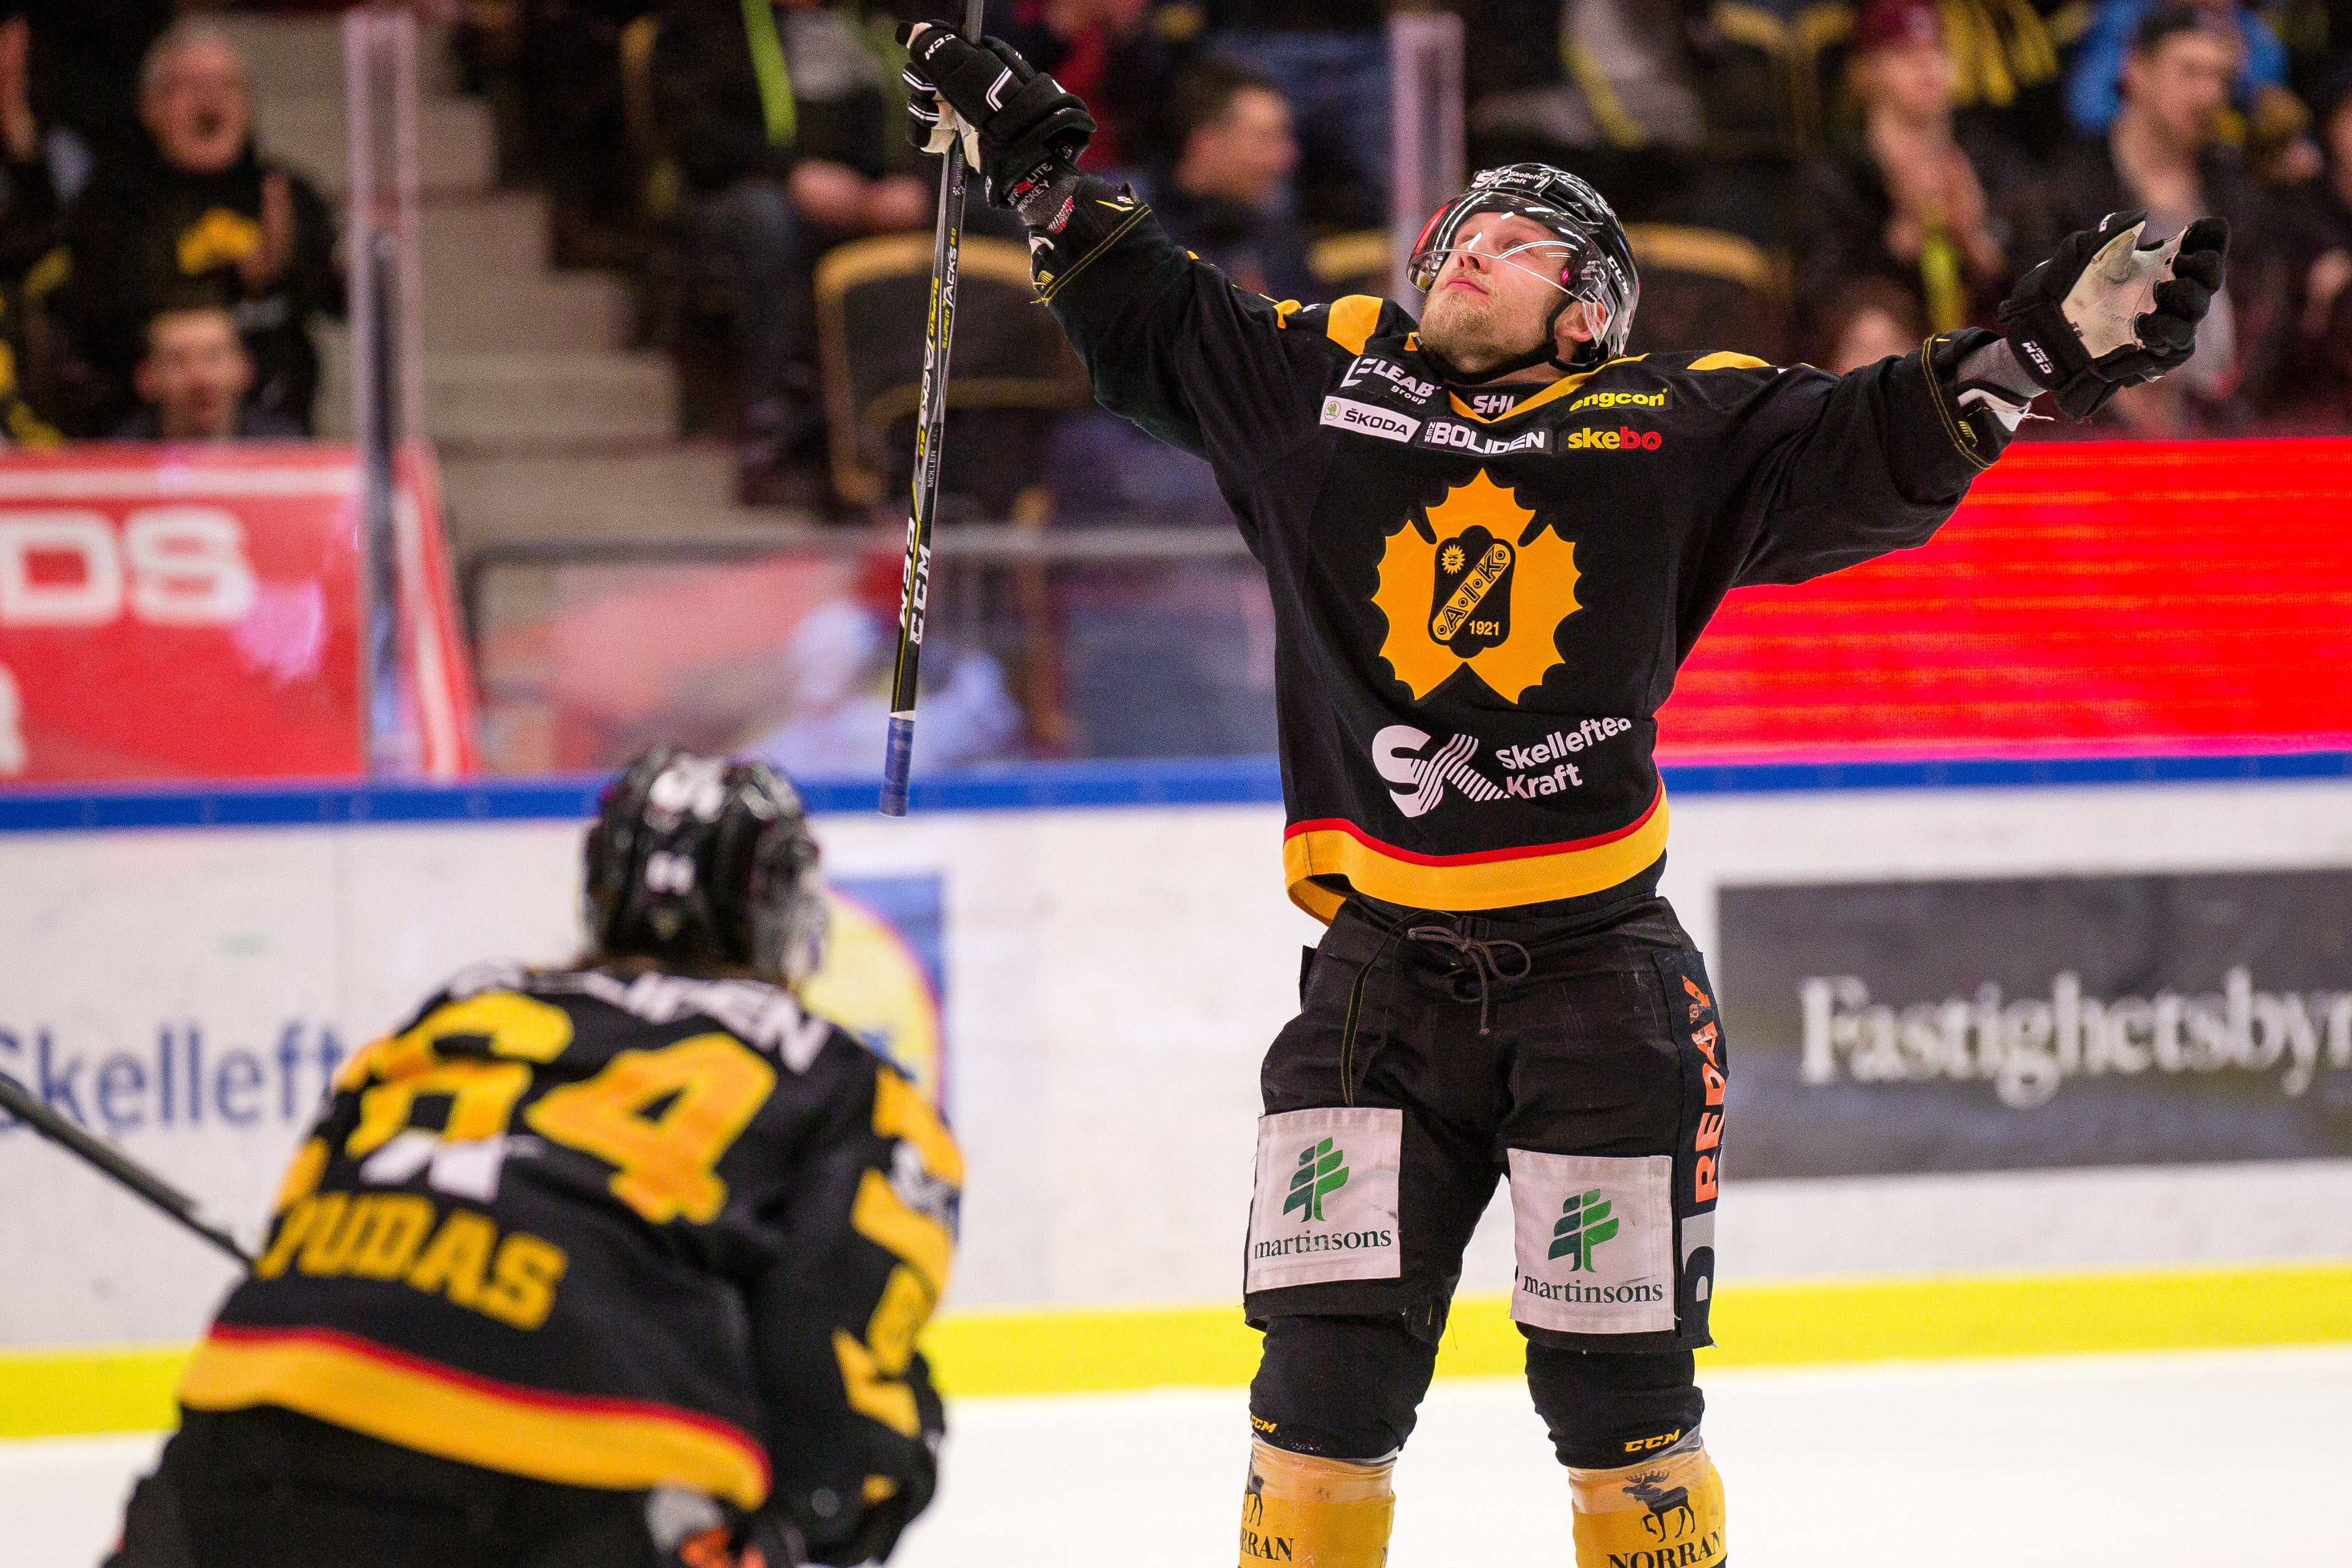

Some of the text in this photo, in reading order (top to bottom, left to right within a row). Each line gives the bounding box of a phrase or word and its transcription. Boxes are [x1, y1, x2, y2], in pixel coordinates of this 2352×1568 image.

[2021, 342, 2052, 374] CCM
[1391, 385, 1427, 405] group
[1569, 392, 1665, 412] engcon
[1343, 407, 1408, 437] ŠKODA
[1431, 422, 1545, 454] BOLIDEN
[1567, 426, 1662, 450] skebo
[909, 544, 931, 645] CCM
[1469, 620, 1499, 636] 1921
[1506, 763, 1583, 800] Kraft
[1254, 1226, 1392, 1260] martinsons
[1522, 1274, 1663, 1304] martinsons
[1624, 1429, 1680, 1453] CCM
